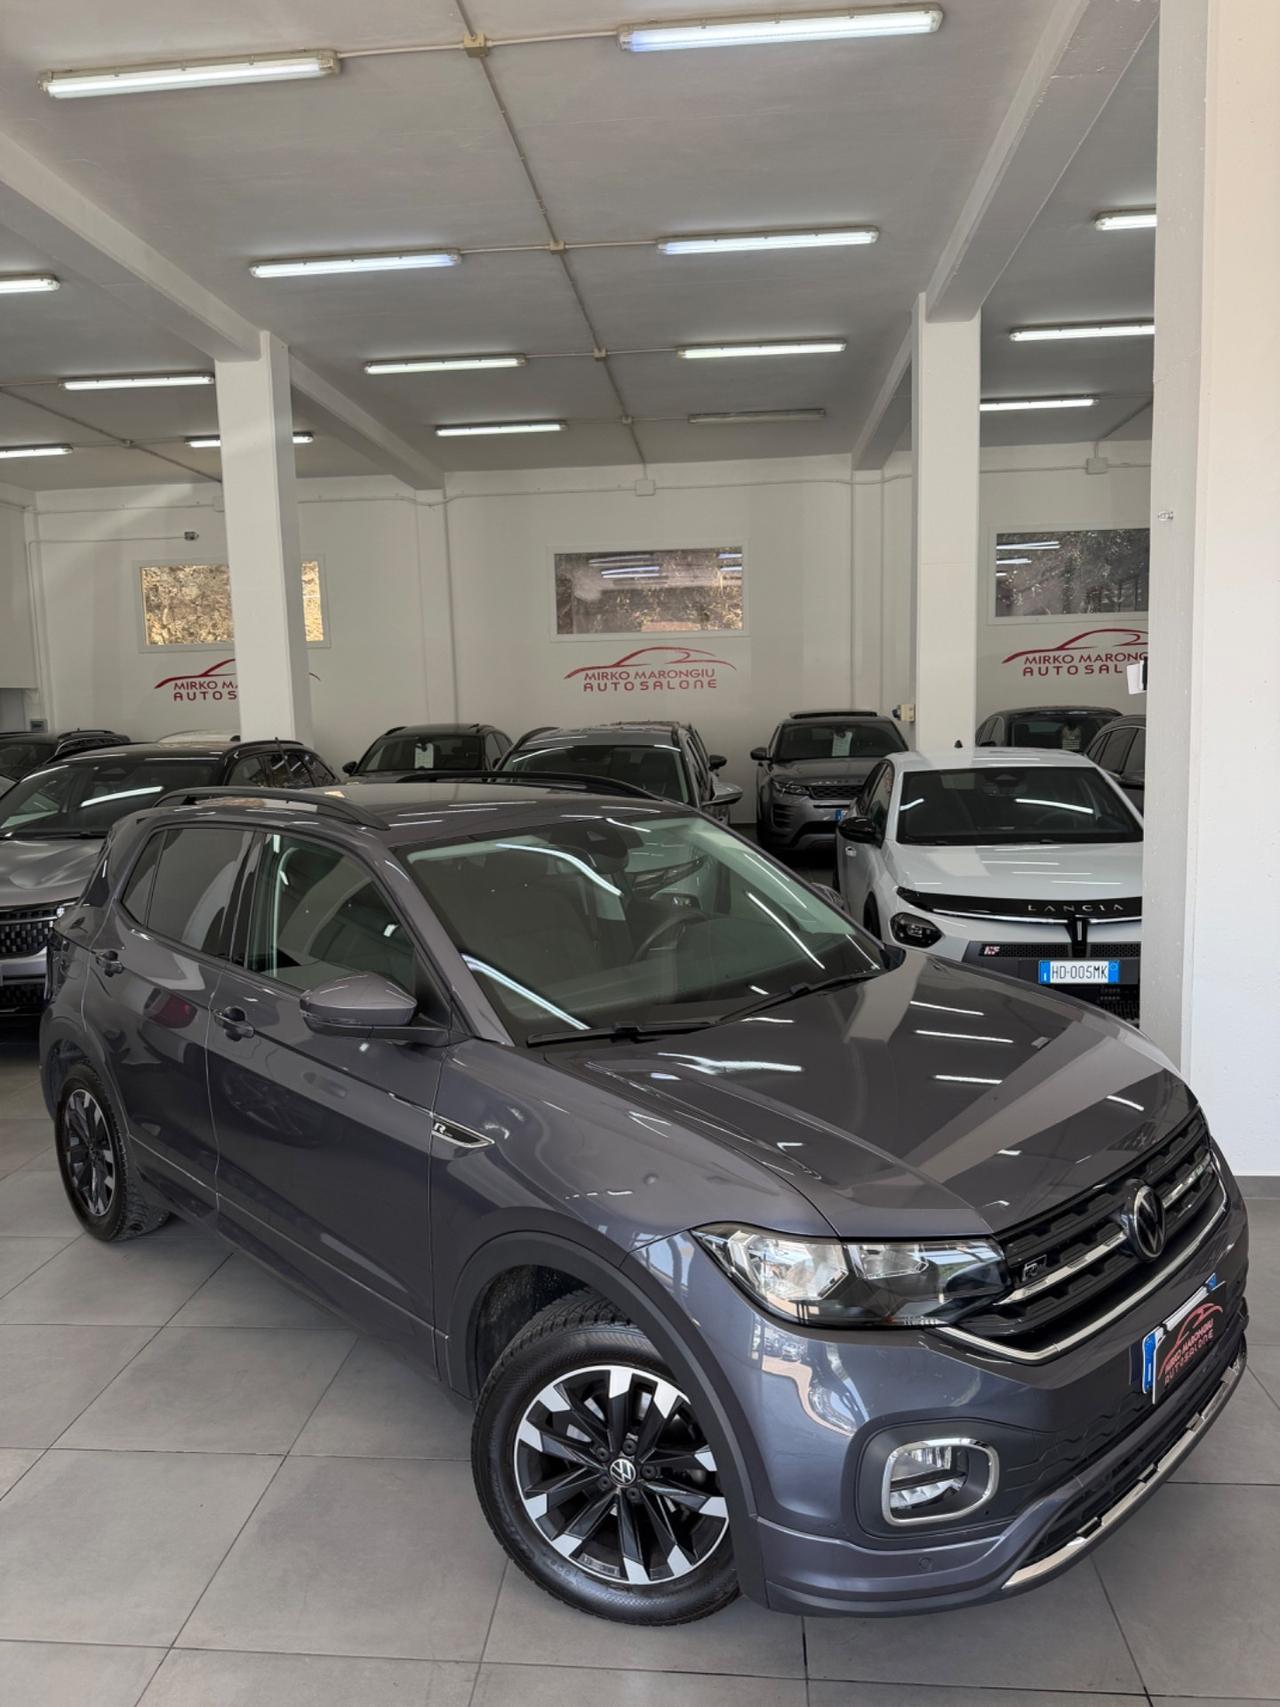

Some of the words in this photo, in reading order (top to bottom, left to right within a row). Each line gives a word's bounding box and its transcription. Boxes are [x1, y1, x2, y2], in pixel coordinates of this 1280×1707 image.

[1024, 654, 1074, 665] MIRKO
[584, 670, 630, 681] MIRKO
[634, 668, 715, 680] MARONGIU
[173, 680, 218, 691] MIRKO
[583, 679, 717, 692] AUTOSALONE
[1028, 904, 1124, 912] LANCIA
